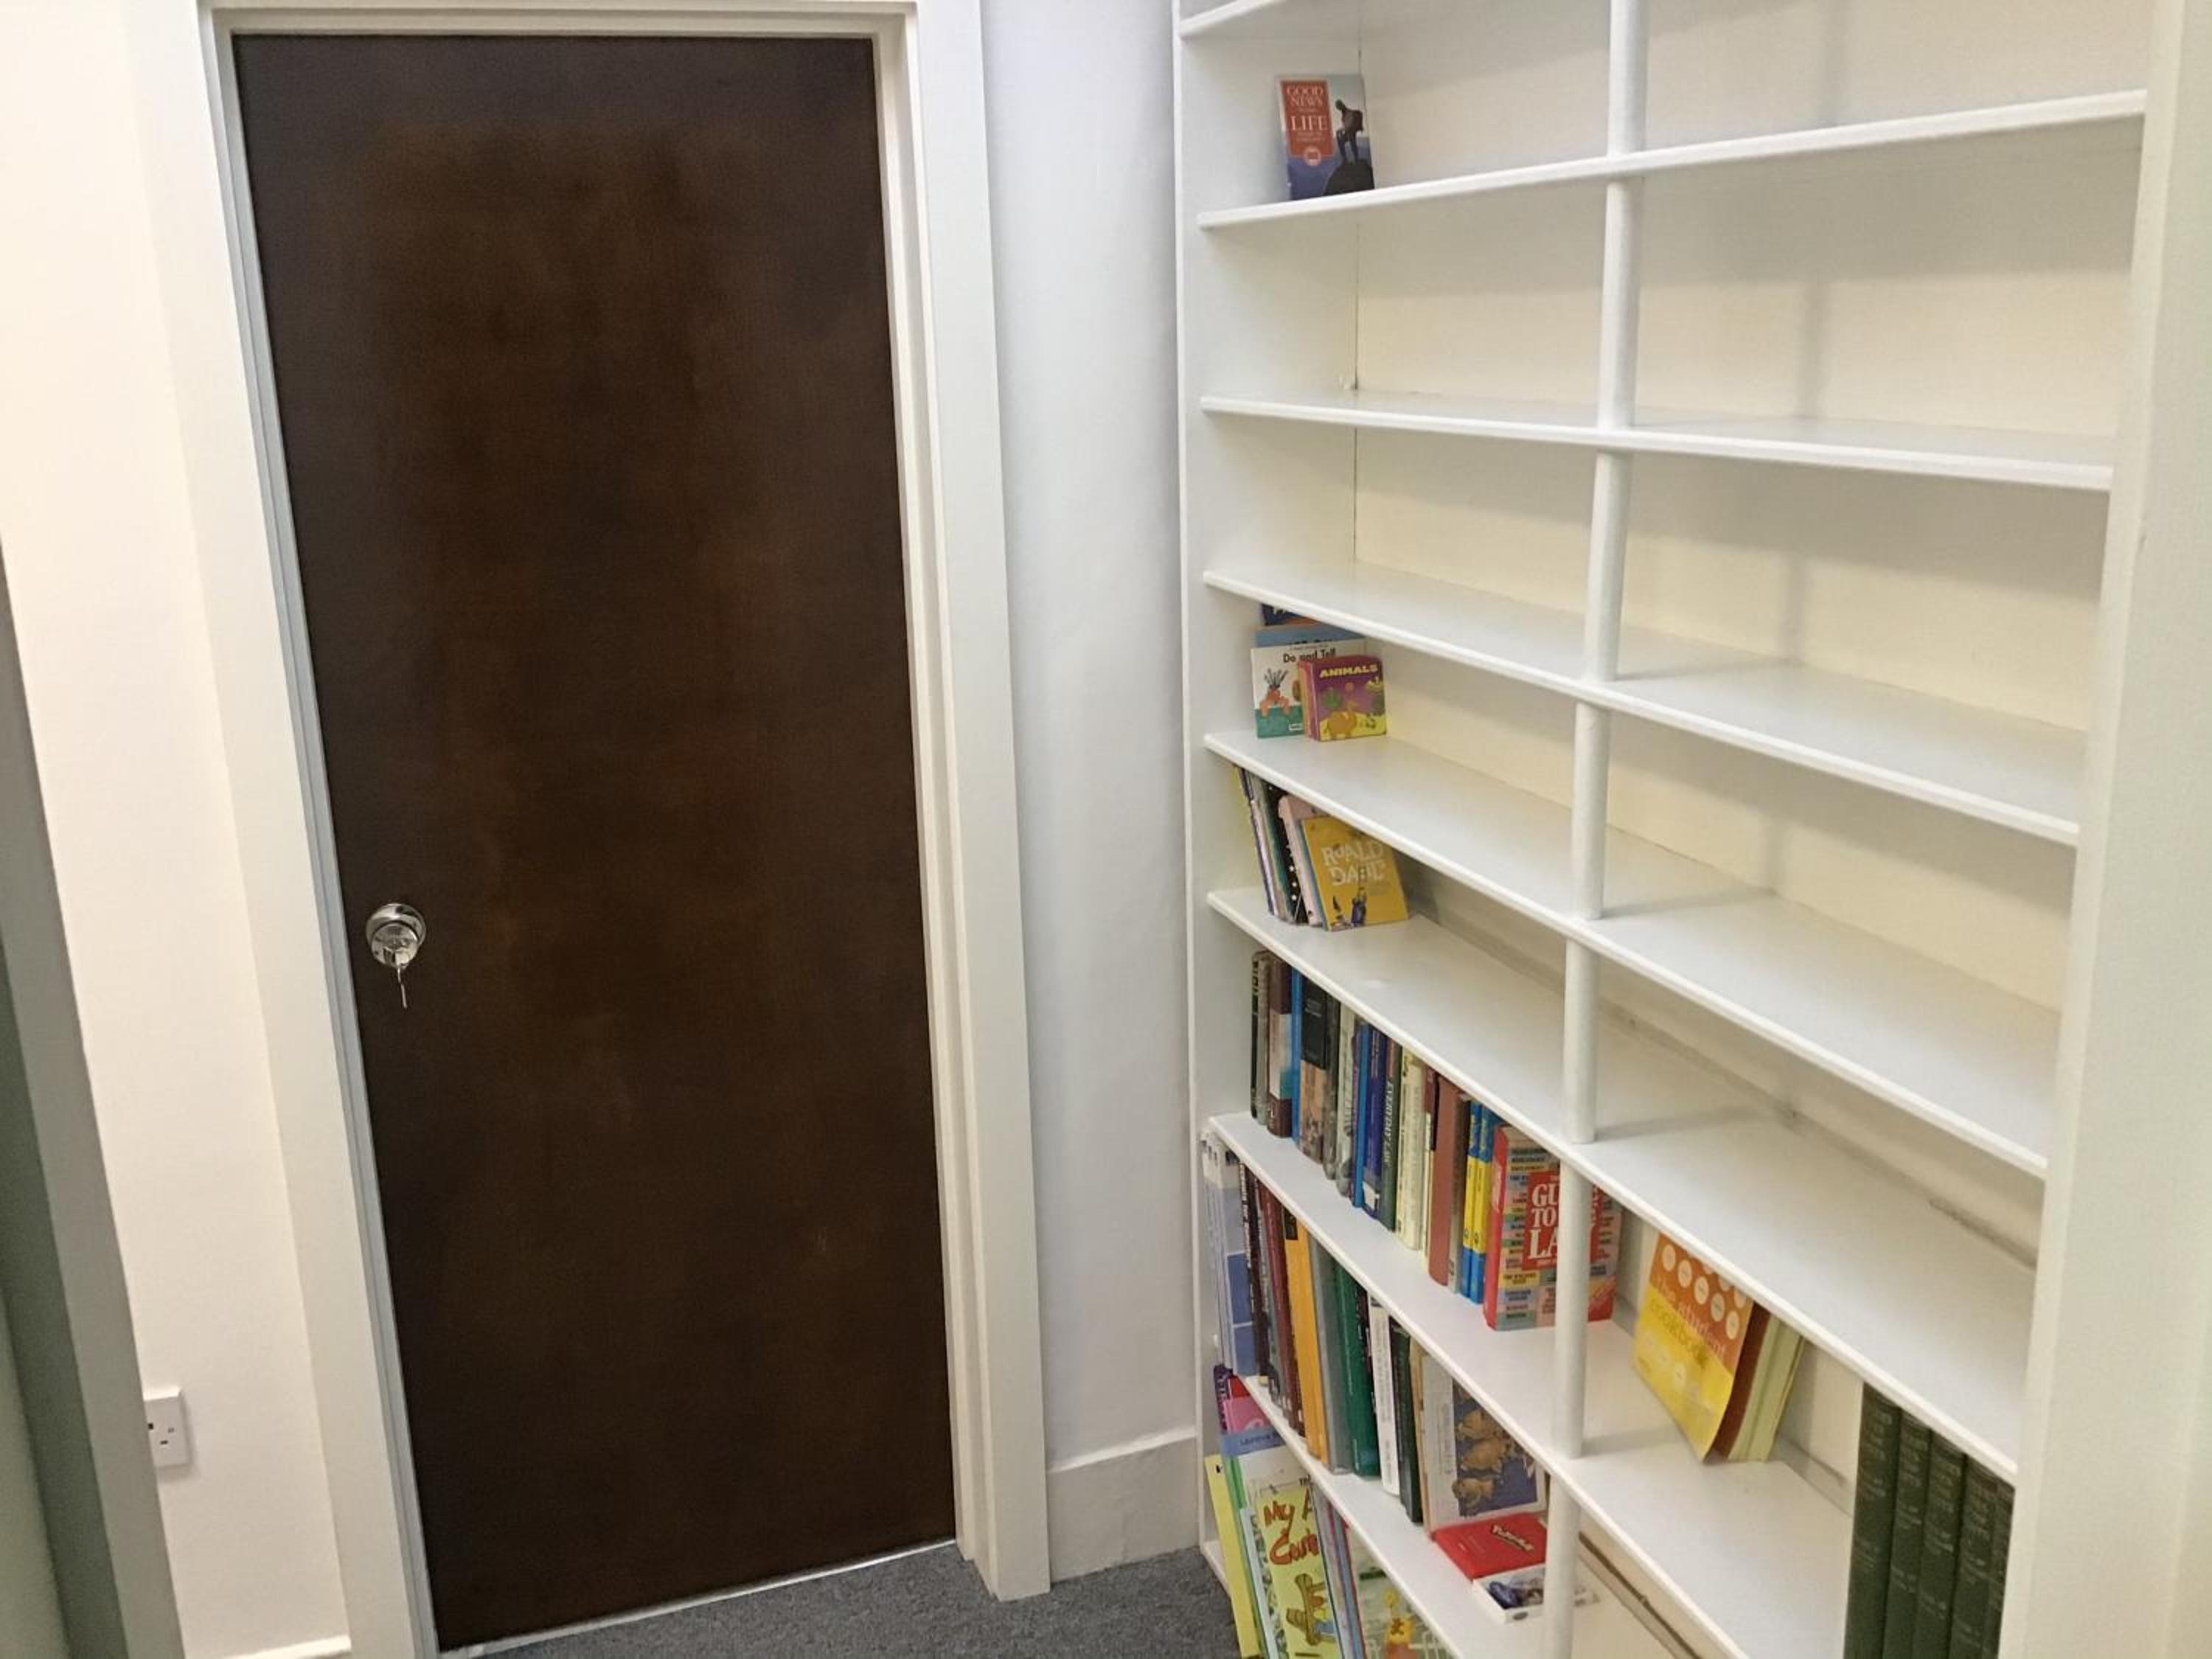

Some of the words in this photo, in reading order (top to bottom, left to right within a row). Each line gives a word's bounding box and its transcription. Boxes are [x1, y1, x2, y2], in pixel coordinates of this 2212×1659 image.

[1287, 85, 1324, 95] GOOD
[1290, 95, 1324, 107] NEWS
[1291, 115, 1327, 130] LIFE
[1282, 653, 1296, 663] Do
[1298, 650, 1318, 661] and
[1319, 663, 1378, 678] ANIMALS
[1321, 841, 1384, 866] ROALD
[1328, 860, 1385, 886] DAHL
[1531, 1206, 1559, 1228] TO
